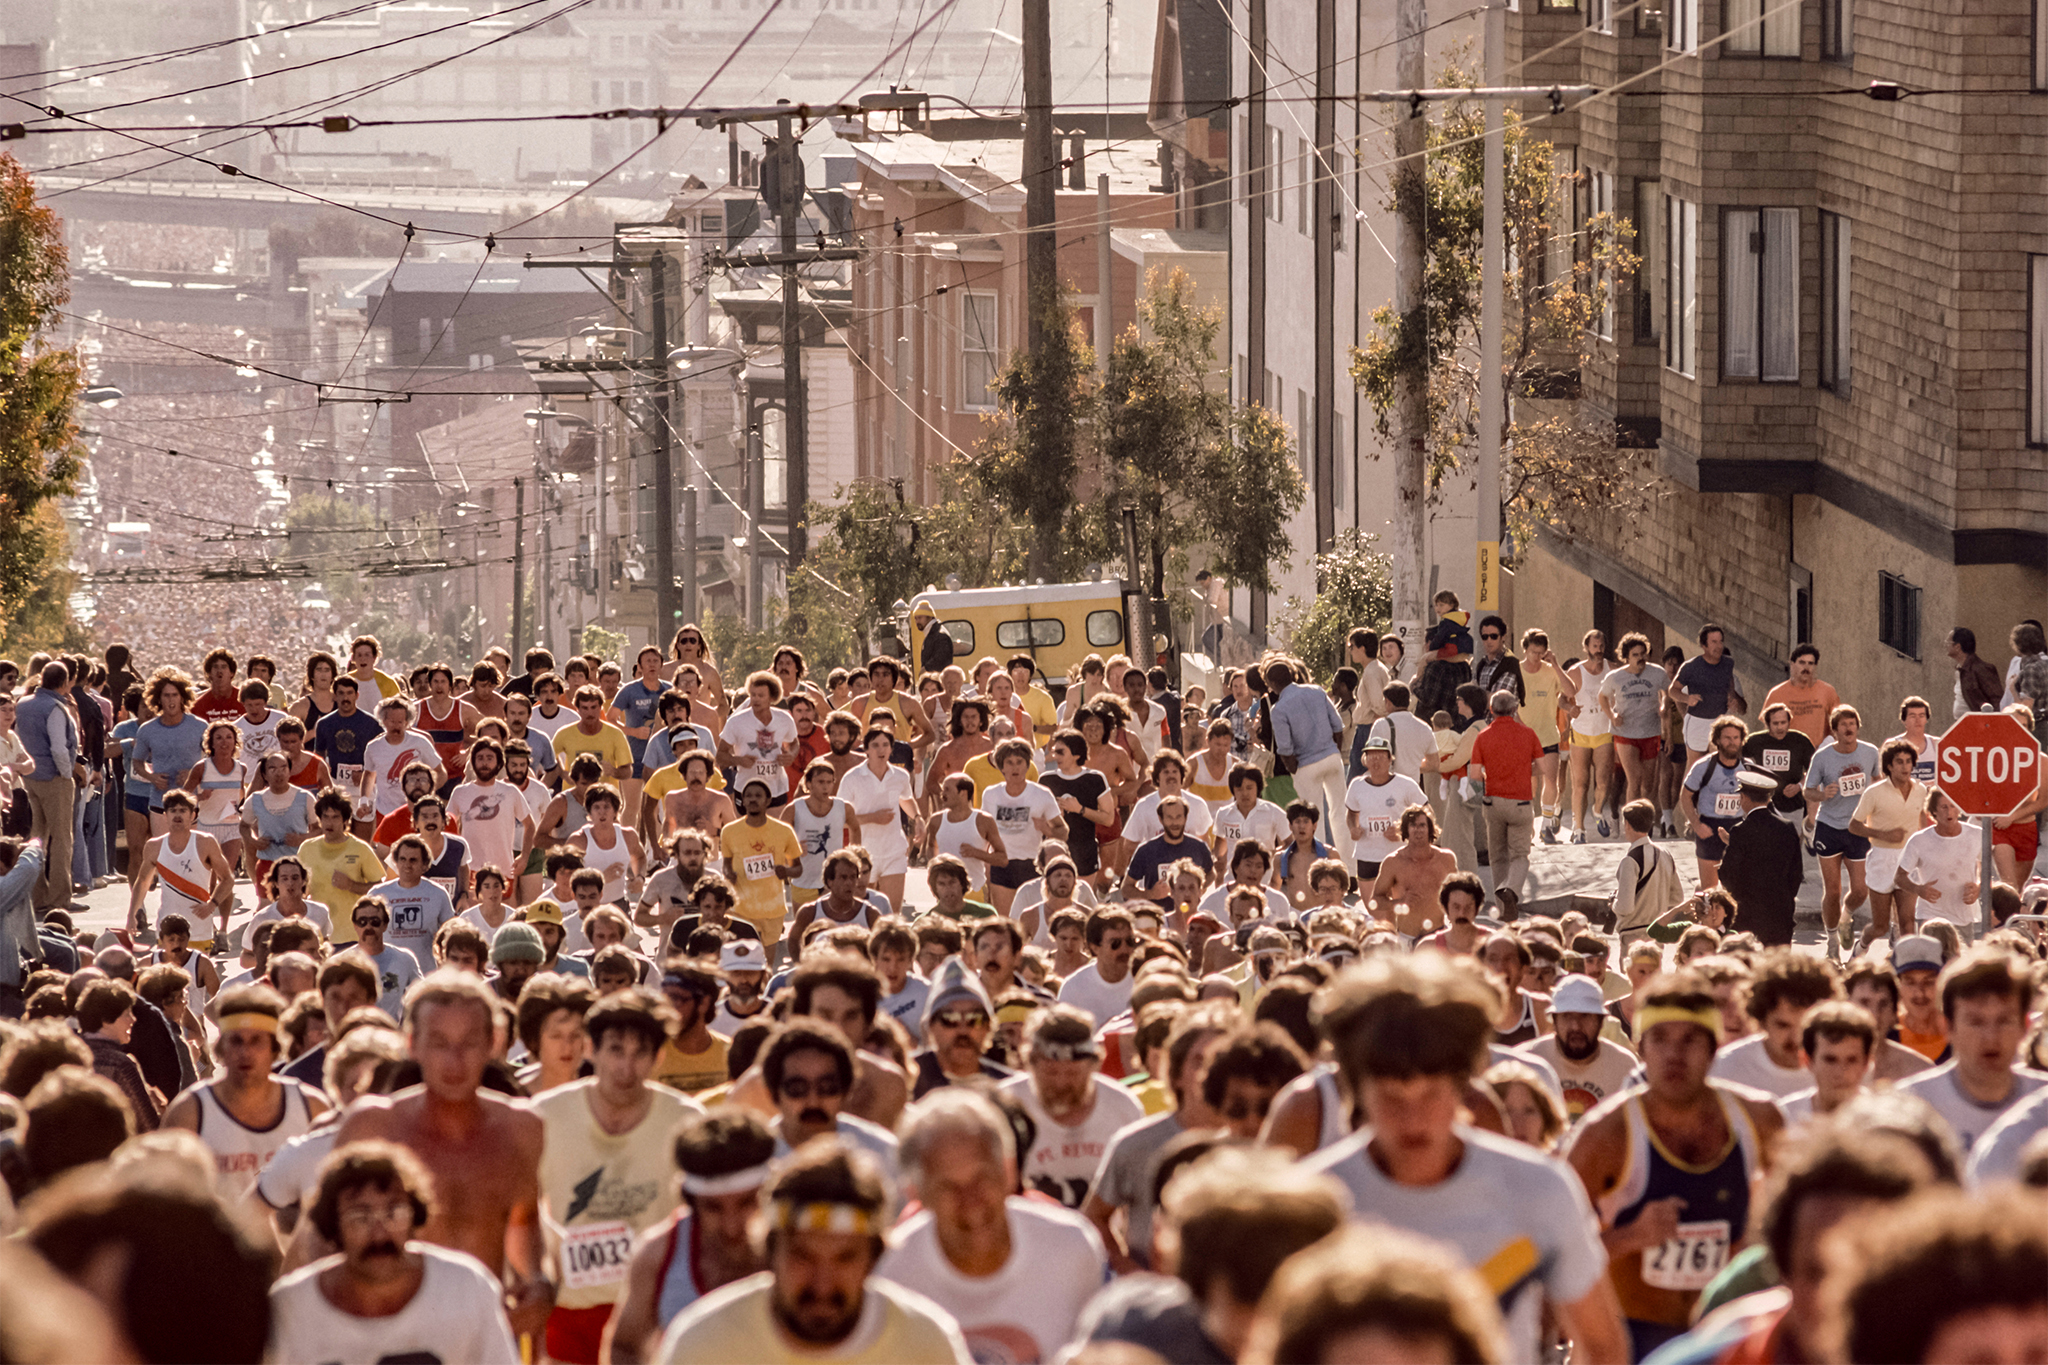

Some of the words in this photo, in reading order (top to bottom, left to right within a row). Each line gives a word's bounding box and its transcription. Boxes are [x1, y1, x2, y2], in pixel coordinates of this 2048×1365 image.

[1480, 572, 1488, 603] STOP
[1399, 626, 1407, 638] 9
[1765, 755, 1788, 766] 5105
[1940, 746, 1985, 784] STOP
[1718, 799, 1741, 810] 6109
[747, 859, 774, 874] 4284
[1652, 1240, 1725, 1272] 2767
